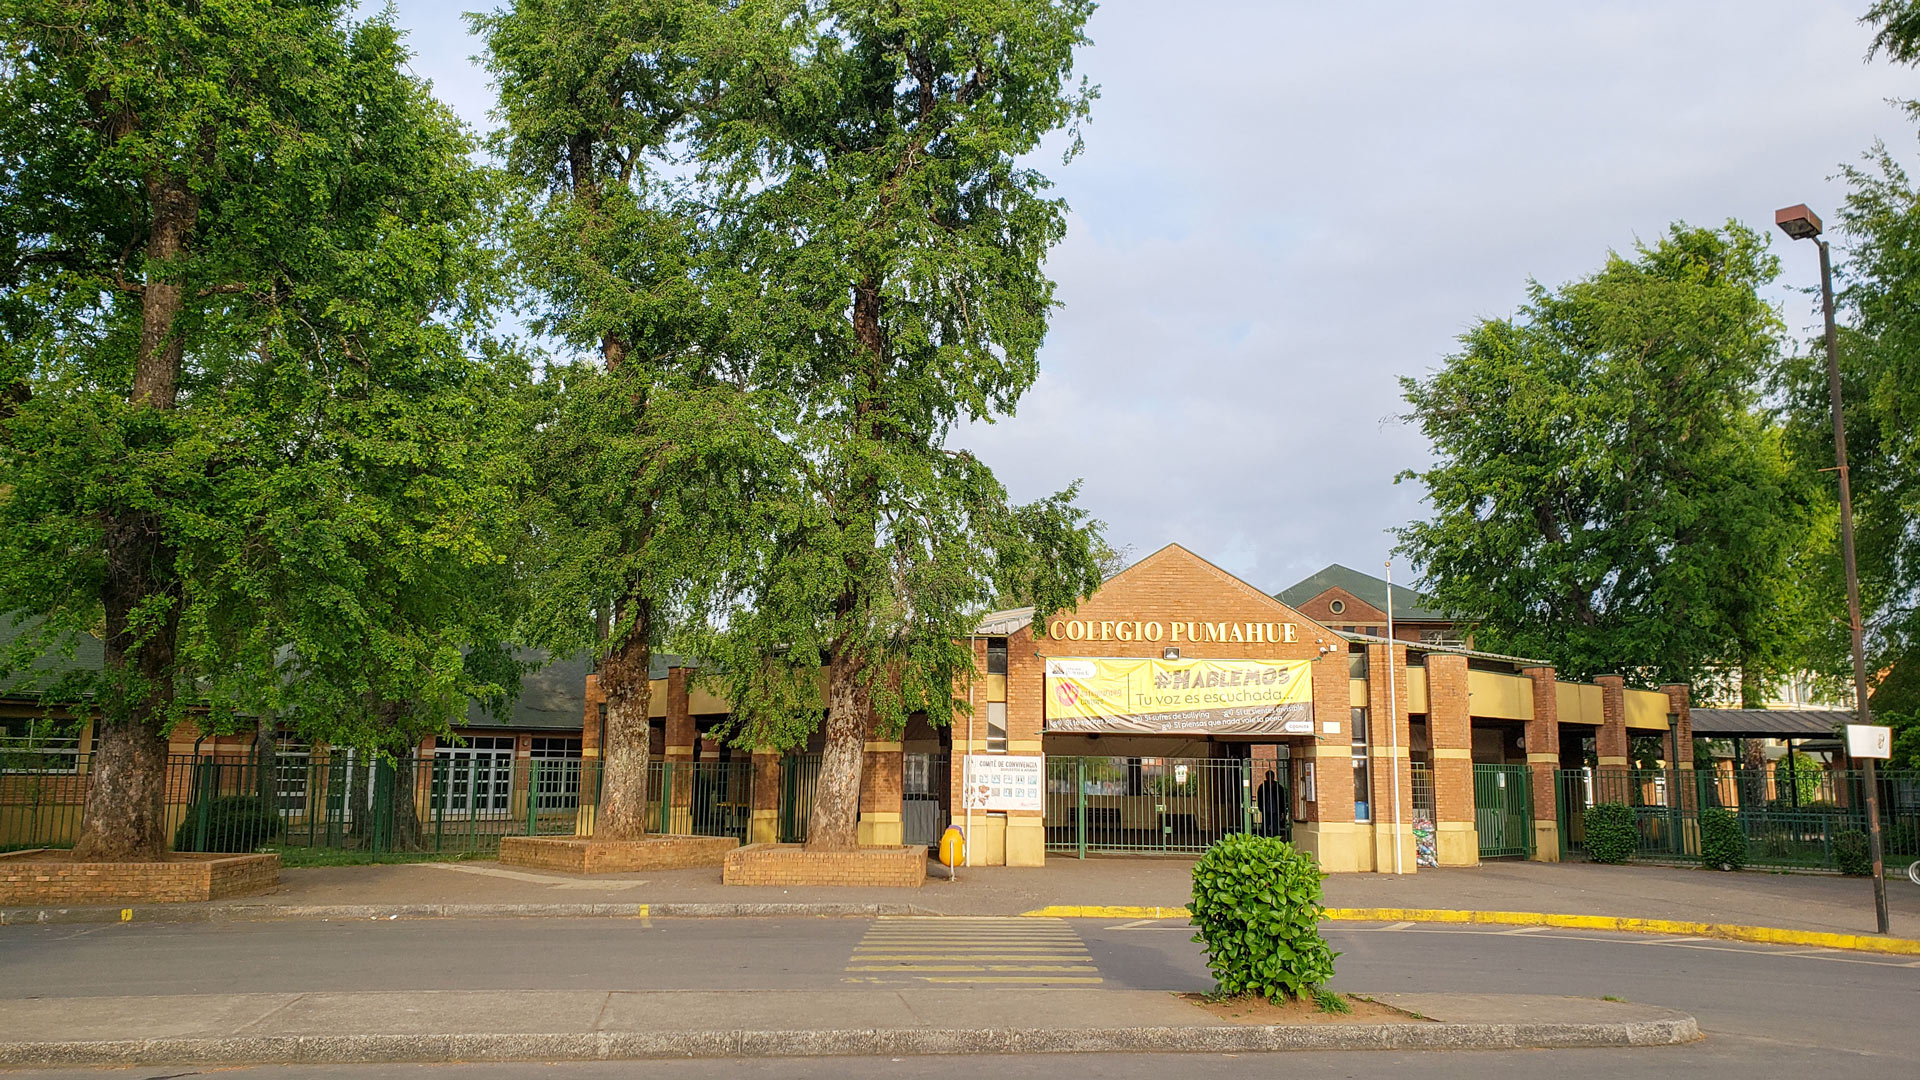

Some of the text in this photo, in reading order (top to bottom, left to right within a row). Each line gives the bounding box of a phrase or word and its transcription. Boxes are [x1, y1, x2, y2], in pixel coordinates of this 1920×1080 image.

[1050, 620, 1299, 643] COLEGIO PUMAHUE
[1154, 667, 1290, 689] #HABLEMOS
[1136, 688, 1293, 706] Tu voz es escuchada...
[1182, 720, 1207, 729] piensas
[1222, 717, 1240, 725] nada
[1183, 711, 1209, 719] bullying
